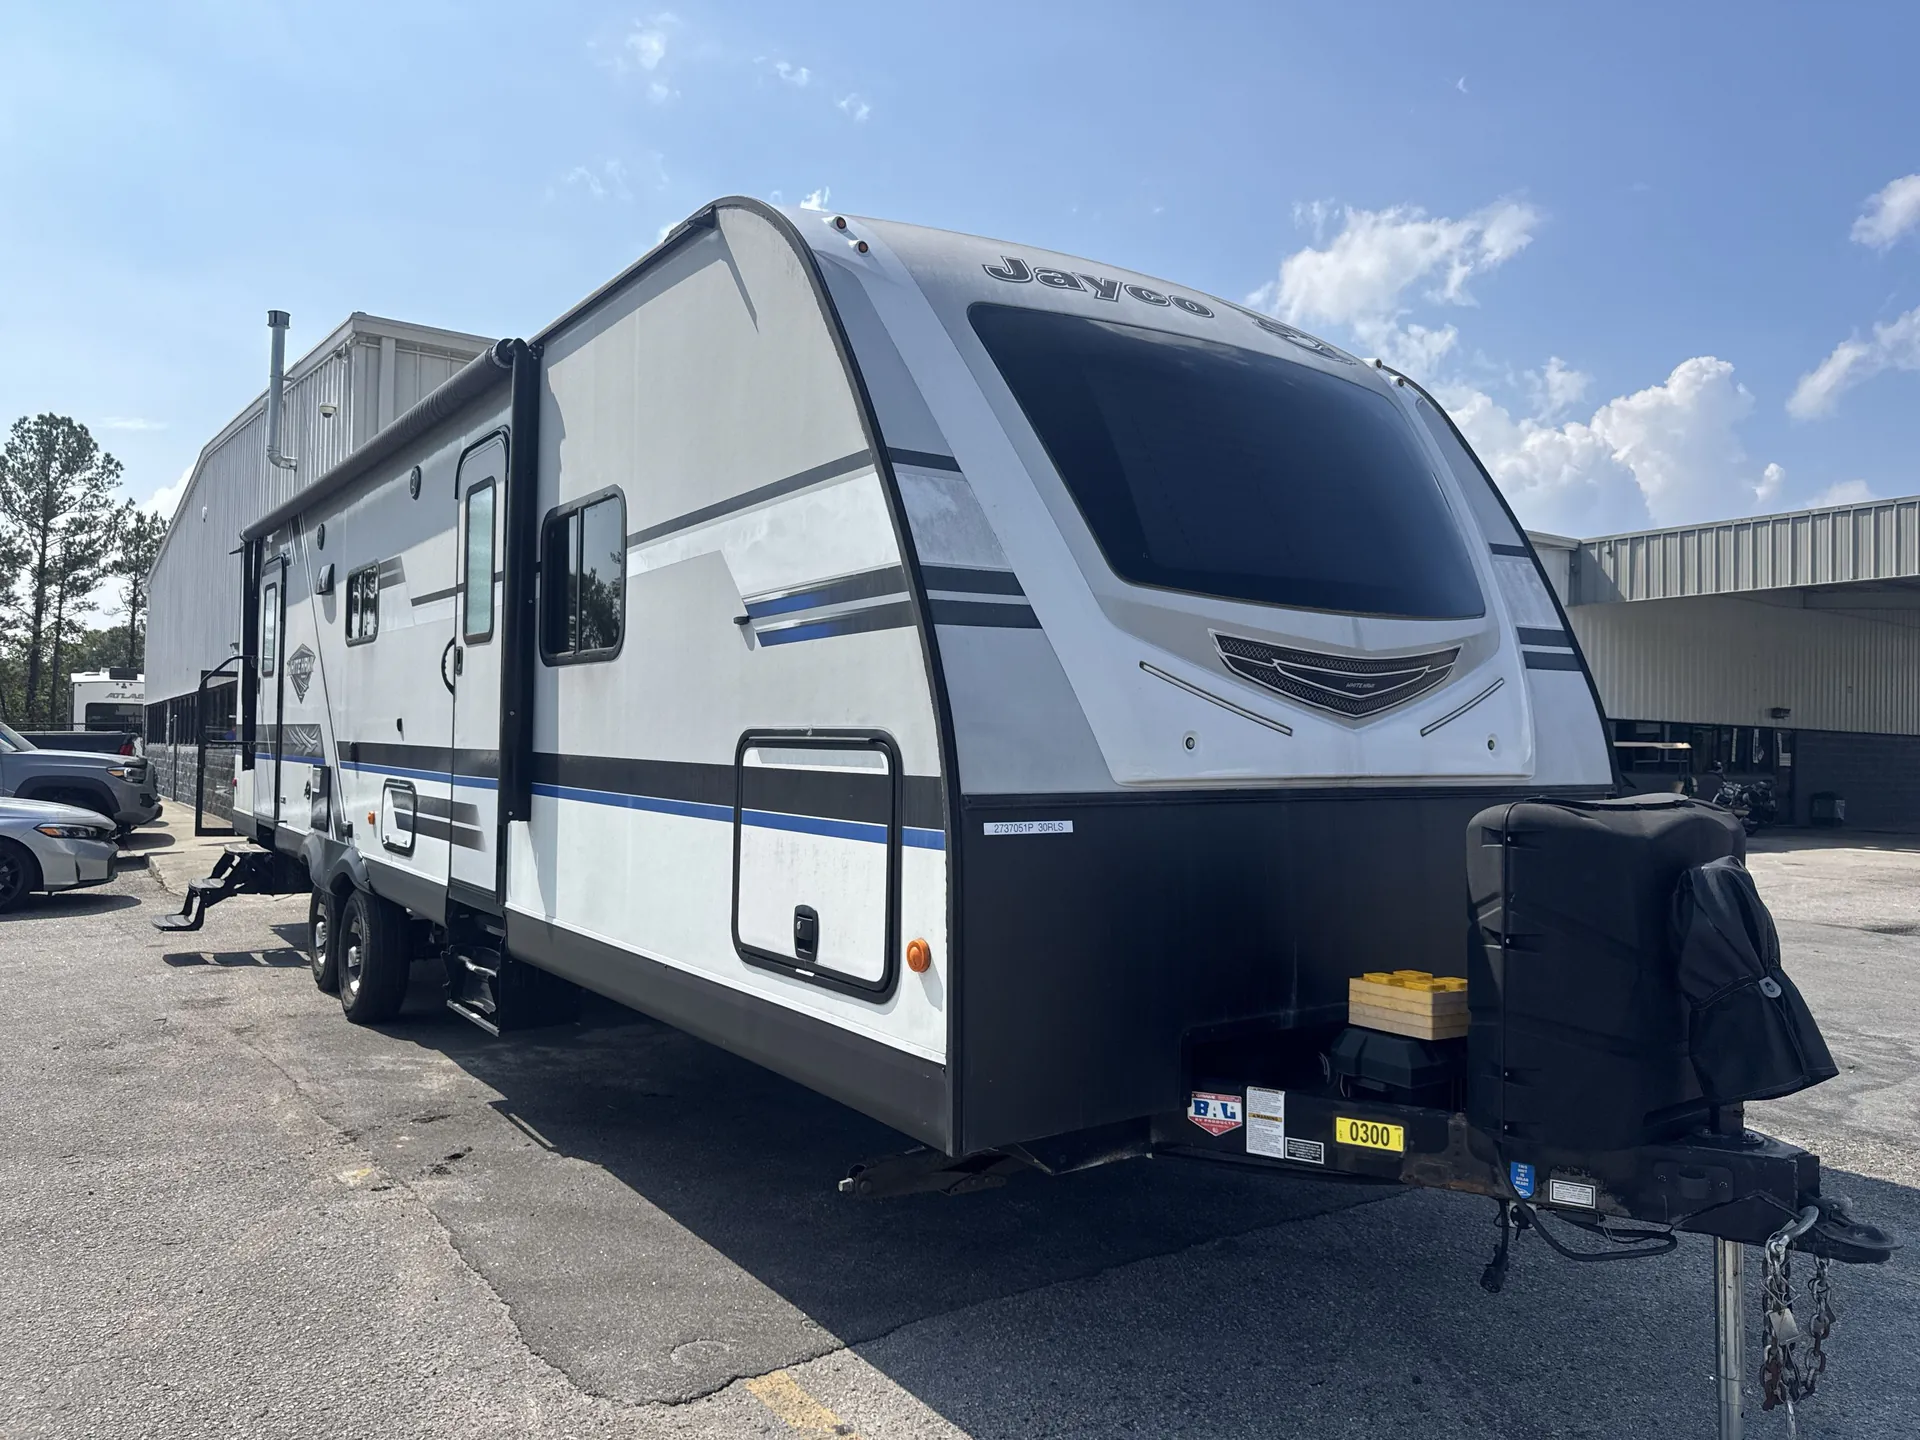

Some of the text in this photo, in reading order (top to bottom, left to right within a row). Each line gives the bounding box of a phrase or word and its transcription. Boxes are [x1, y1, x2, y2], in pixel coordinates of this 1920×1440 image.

[981, 255, 1216, 319] Jayco
[994, 822, 1064, 833] 2737051P 30RLS
[1350, 1121, 1390, 1146] 0300
